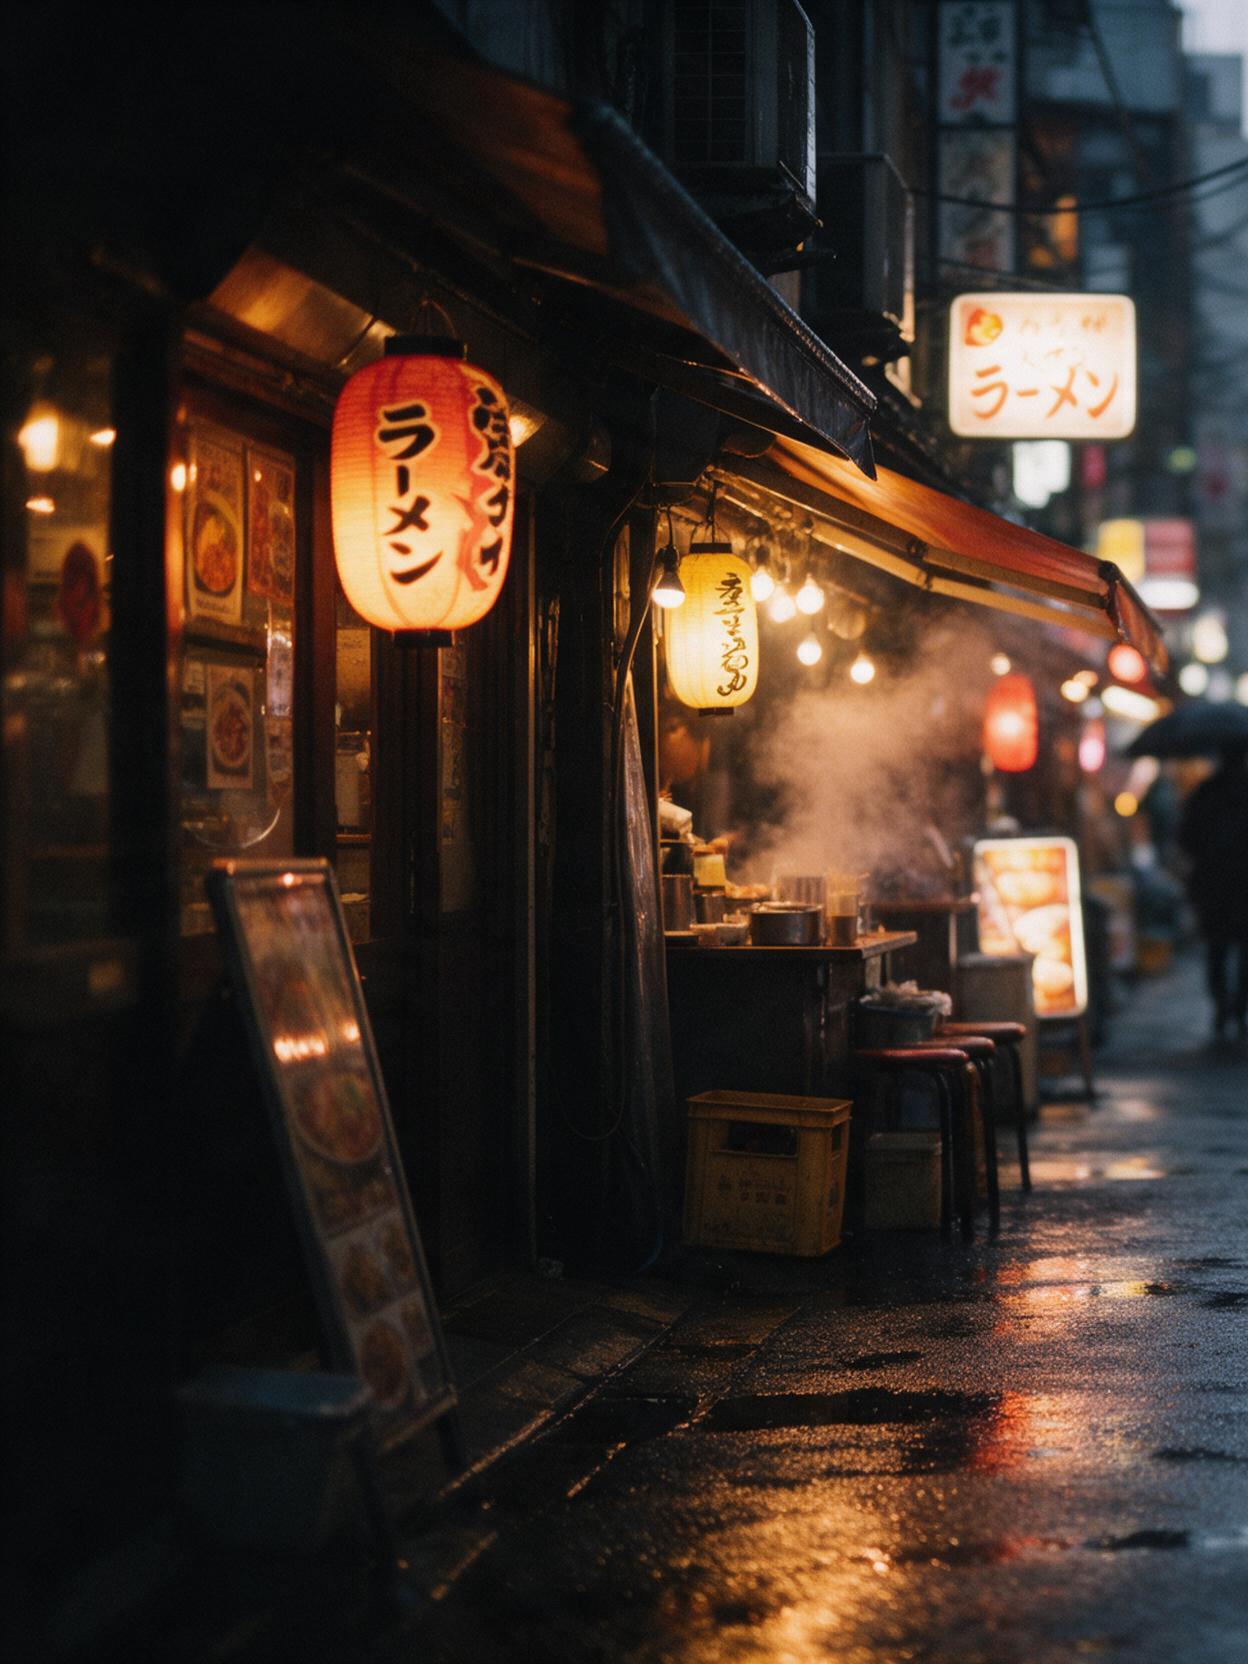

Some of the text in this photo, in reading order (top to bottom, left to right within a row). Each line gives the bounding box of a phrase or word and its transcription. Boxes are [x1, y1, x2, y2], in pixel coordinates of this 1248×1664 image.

[970, 364, 1120, 421] ラーメン
[377, 403, 443, 585] ラーメン
